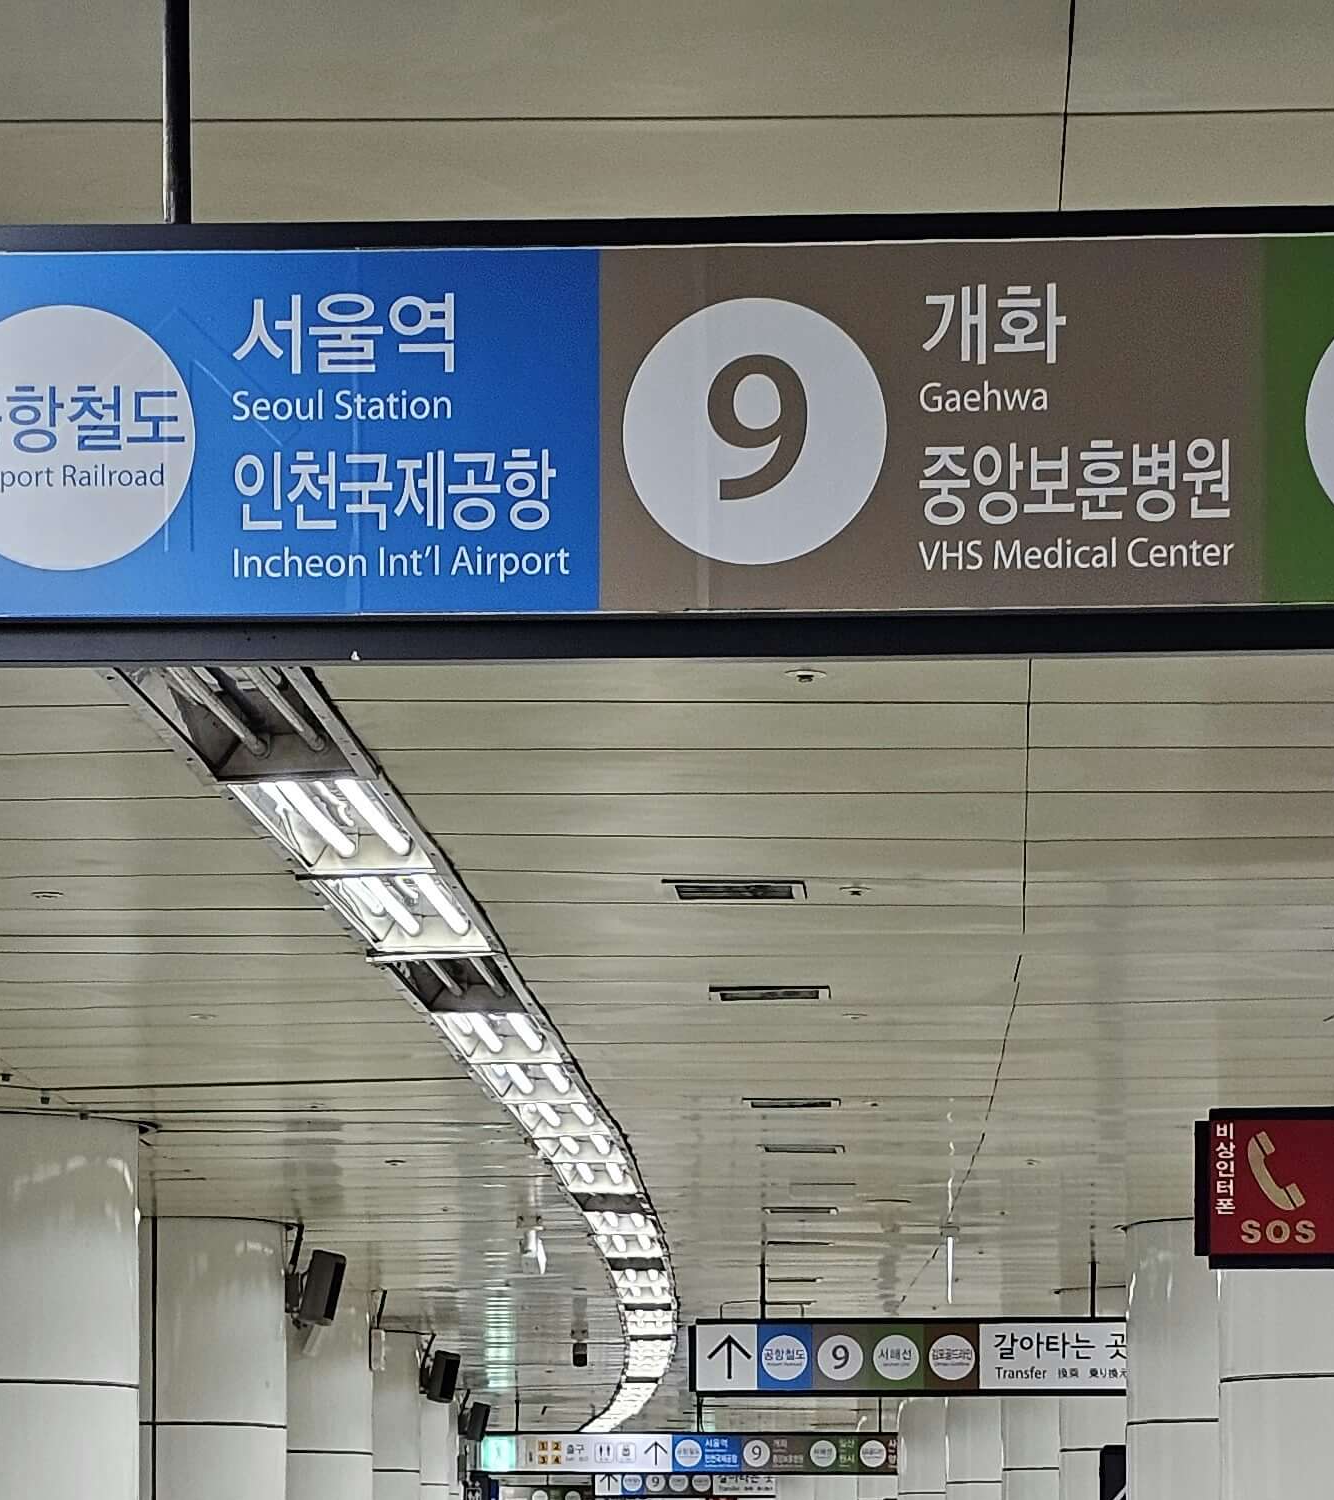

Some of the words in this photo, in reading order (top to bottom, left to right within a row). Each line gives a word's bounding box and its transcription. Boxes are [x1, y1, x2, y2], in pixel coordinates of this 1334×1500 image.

[232, 292, 455, 375] 서울역
[922, 282, 1067, 366] 개화
[232, 388, 324, 421] Seoul
[334, 389, 452, 420] Station
[919, 379, 1048, 413] Gaehwa
[707, 353, 808, 501] 9
[62, 462, 165, 487] Railroad
[234, 448, 557, 531] 인천국제공항
[918, 438, 1231, 526] 중앙보훈병원
[233, 546, 367, 578] Incheon
[450, 545, 570, 583] Airport
[918, 539, 983, 571] VHS
[993, 536, 1117, 570] Medical
[1127, 537, 1235, 568] Center
[1215, 1122, 1236, 1215] 비상인터폰
[1240, 1219, 1316, 1244] SOS
[831, 1345, 850, 1370] 9
[994, 1332, 1096, 1361] 갈아타는
[1105, 1333, 1127, 1360] 곳
[995, 1367, 1047, 1381] Transfer
[751, 1444, 762, 1461] 9
[651, 1476, 660, 1488] 9
